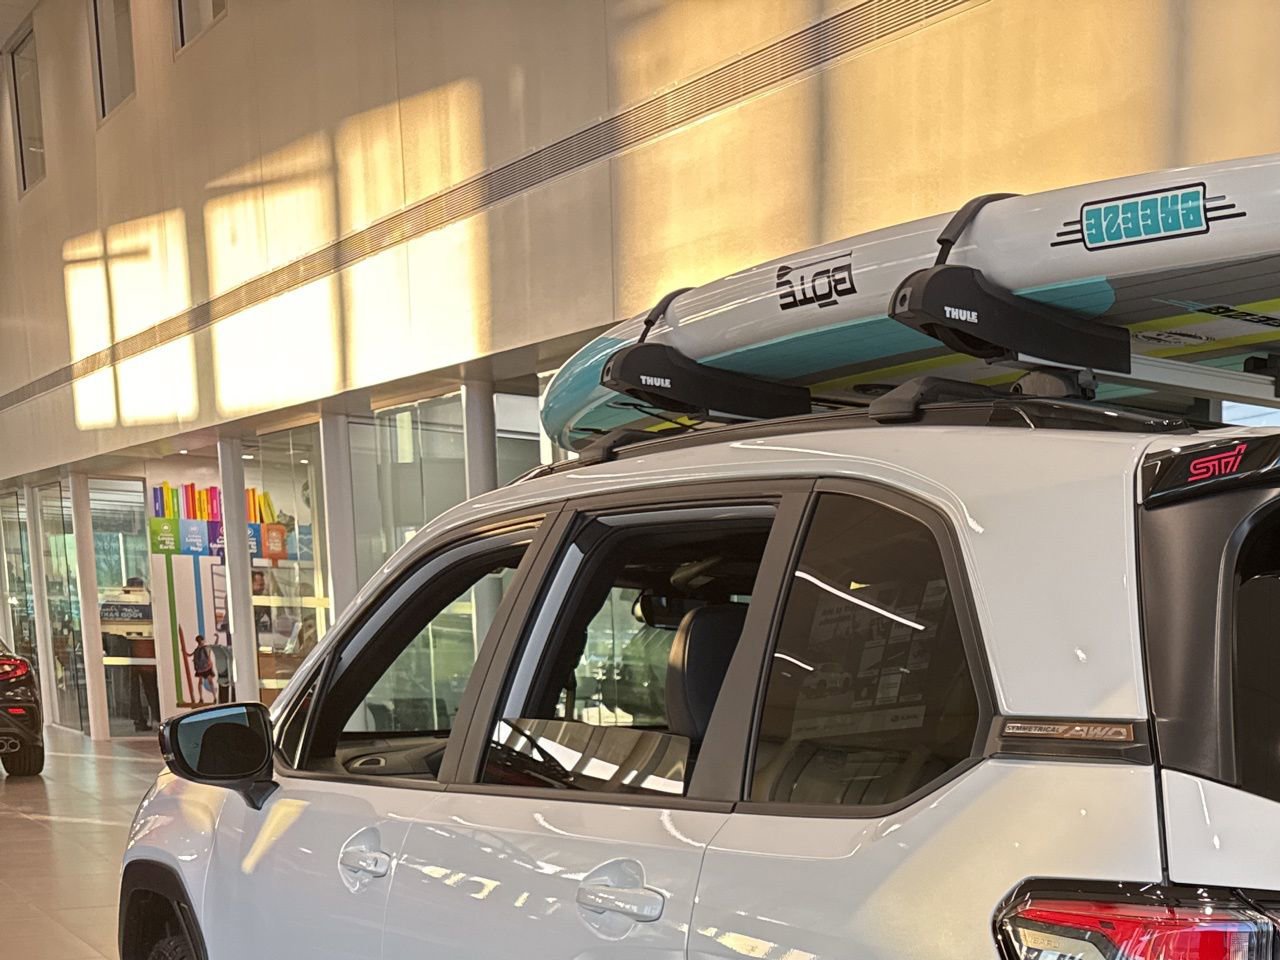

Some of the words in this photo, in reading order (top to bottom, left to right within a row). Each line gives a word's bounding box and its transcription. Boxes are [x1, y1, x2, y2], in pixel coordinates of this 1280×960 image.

[1085, 190, 1204, 245] BREEZE
[944, 305, 978, 323] THULE
[640, 375, 671, 388] THULE
[1064, 725, 1128, 739] AWD
